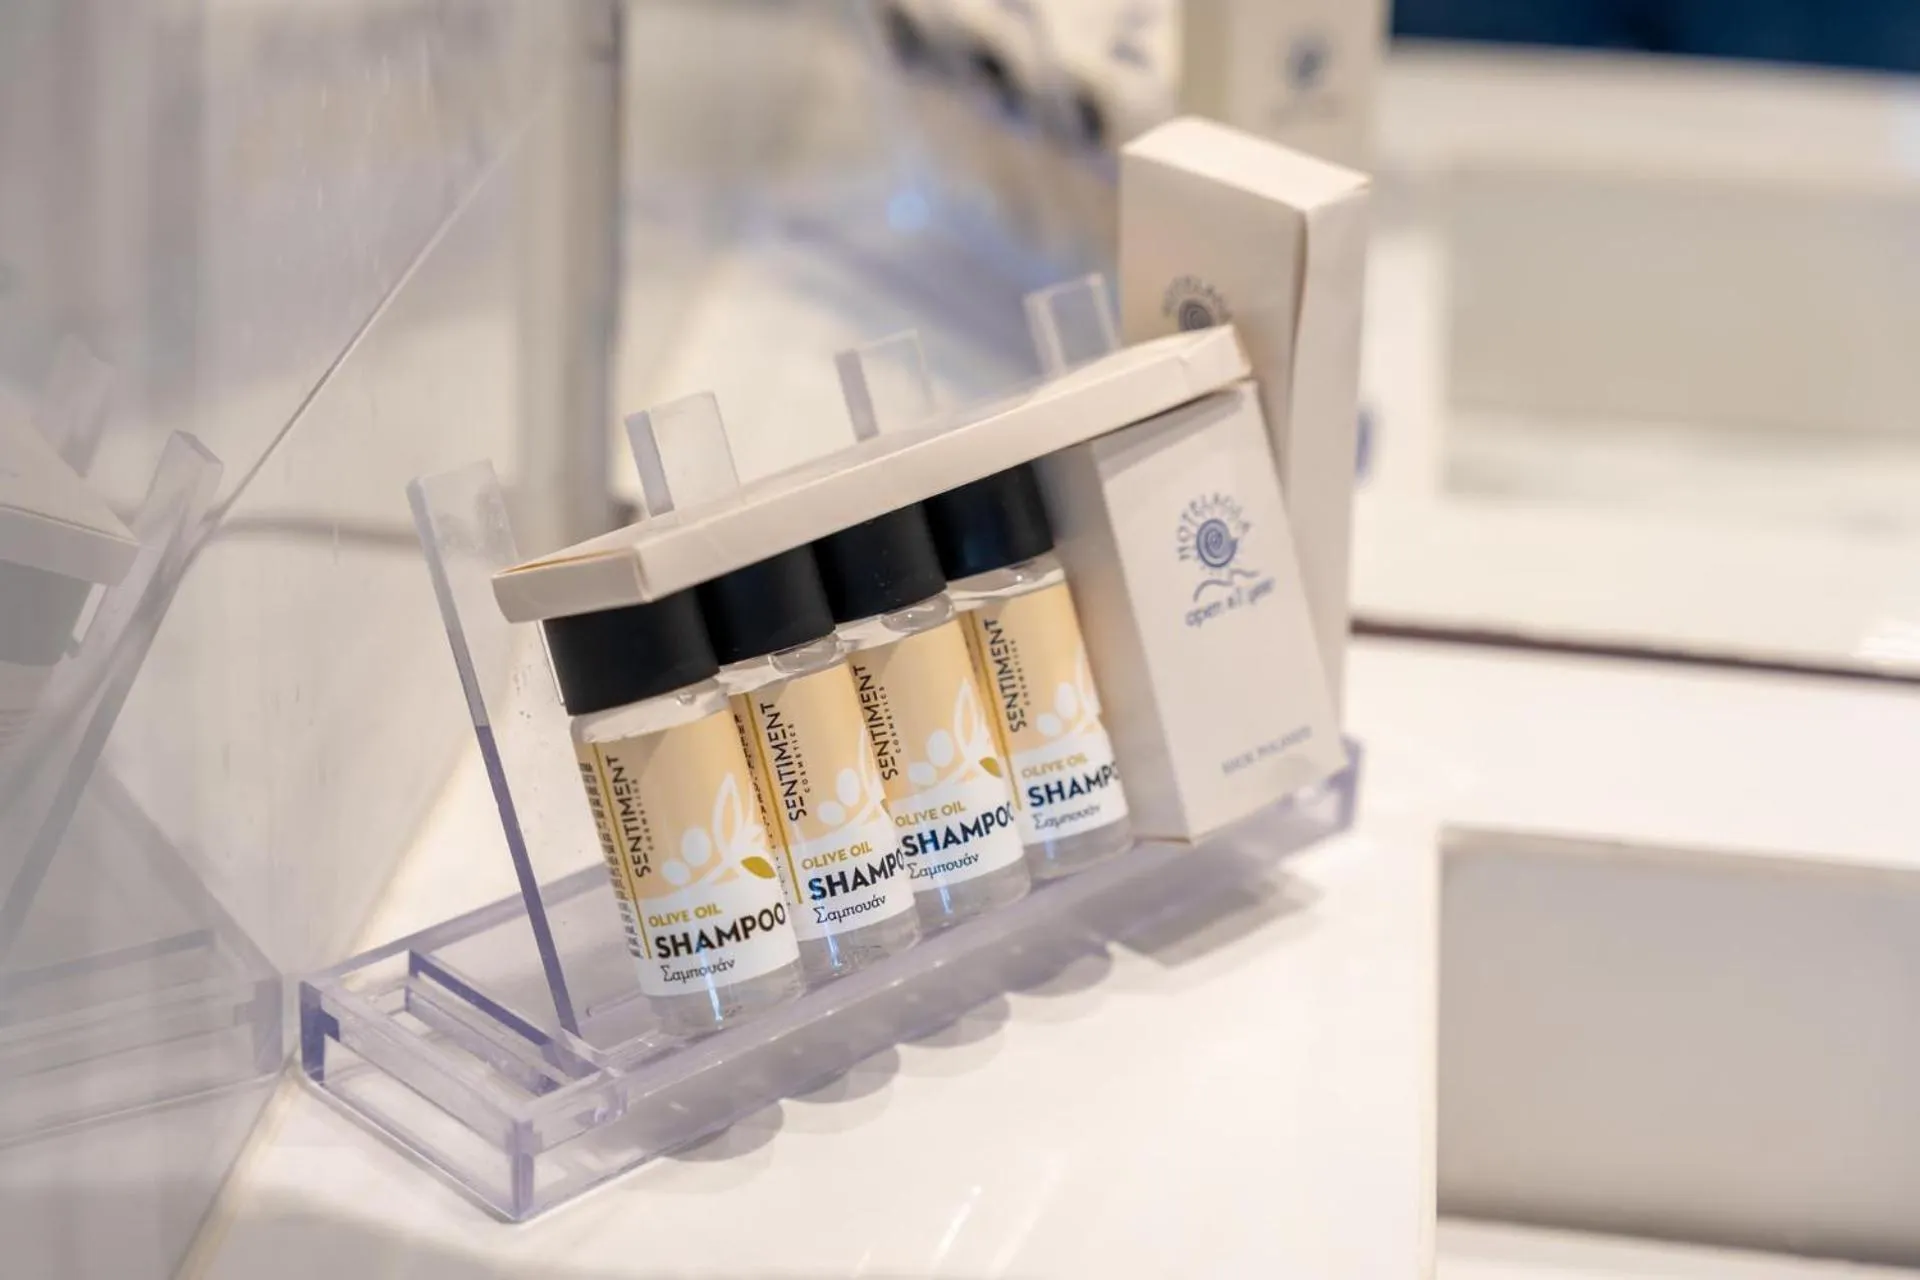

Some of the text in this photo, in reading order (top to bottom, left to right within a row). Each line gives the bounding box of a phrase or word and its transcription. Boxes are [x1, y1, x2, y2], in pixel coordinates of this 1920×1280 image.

[984, 618, 1027, 733] SENTIMENT
[853, 665, 898, 781] SENTIMENT
[760, 702, 807, 822] SENTIMENT
[1021, 752, 1087, 779] OLIVE OIL
[1028, 761, 1119, 807] SHAMP
[606, 756, 652, 878] SENTIMENT
[895, 800, 966, 828] OLIVE OIL
[801, 841, 872, 870] OLIVE OIL
[907, 852, 979, 880] Σαμπουάν
[808, 848, 905, 901] SHAMPO
[648, 903, 722, 927] OLIVE OIL
[813, 894, 886, 923] Σαμπουάν
[655, 902, 787, 959] SHAMPOO
[660, 957, 736, 984] Σαμπουάν
